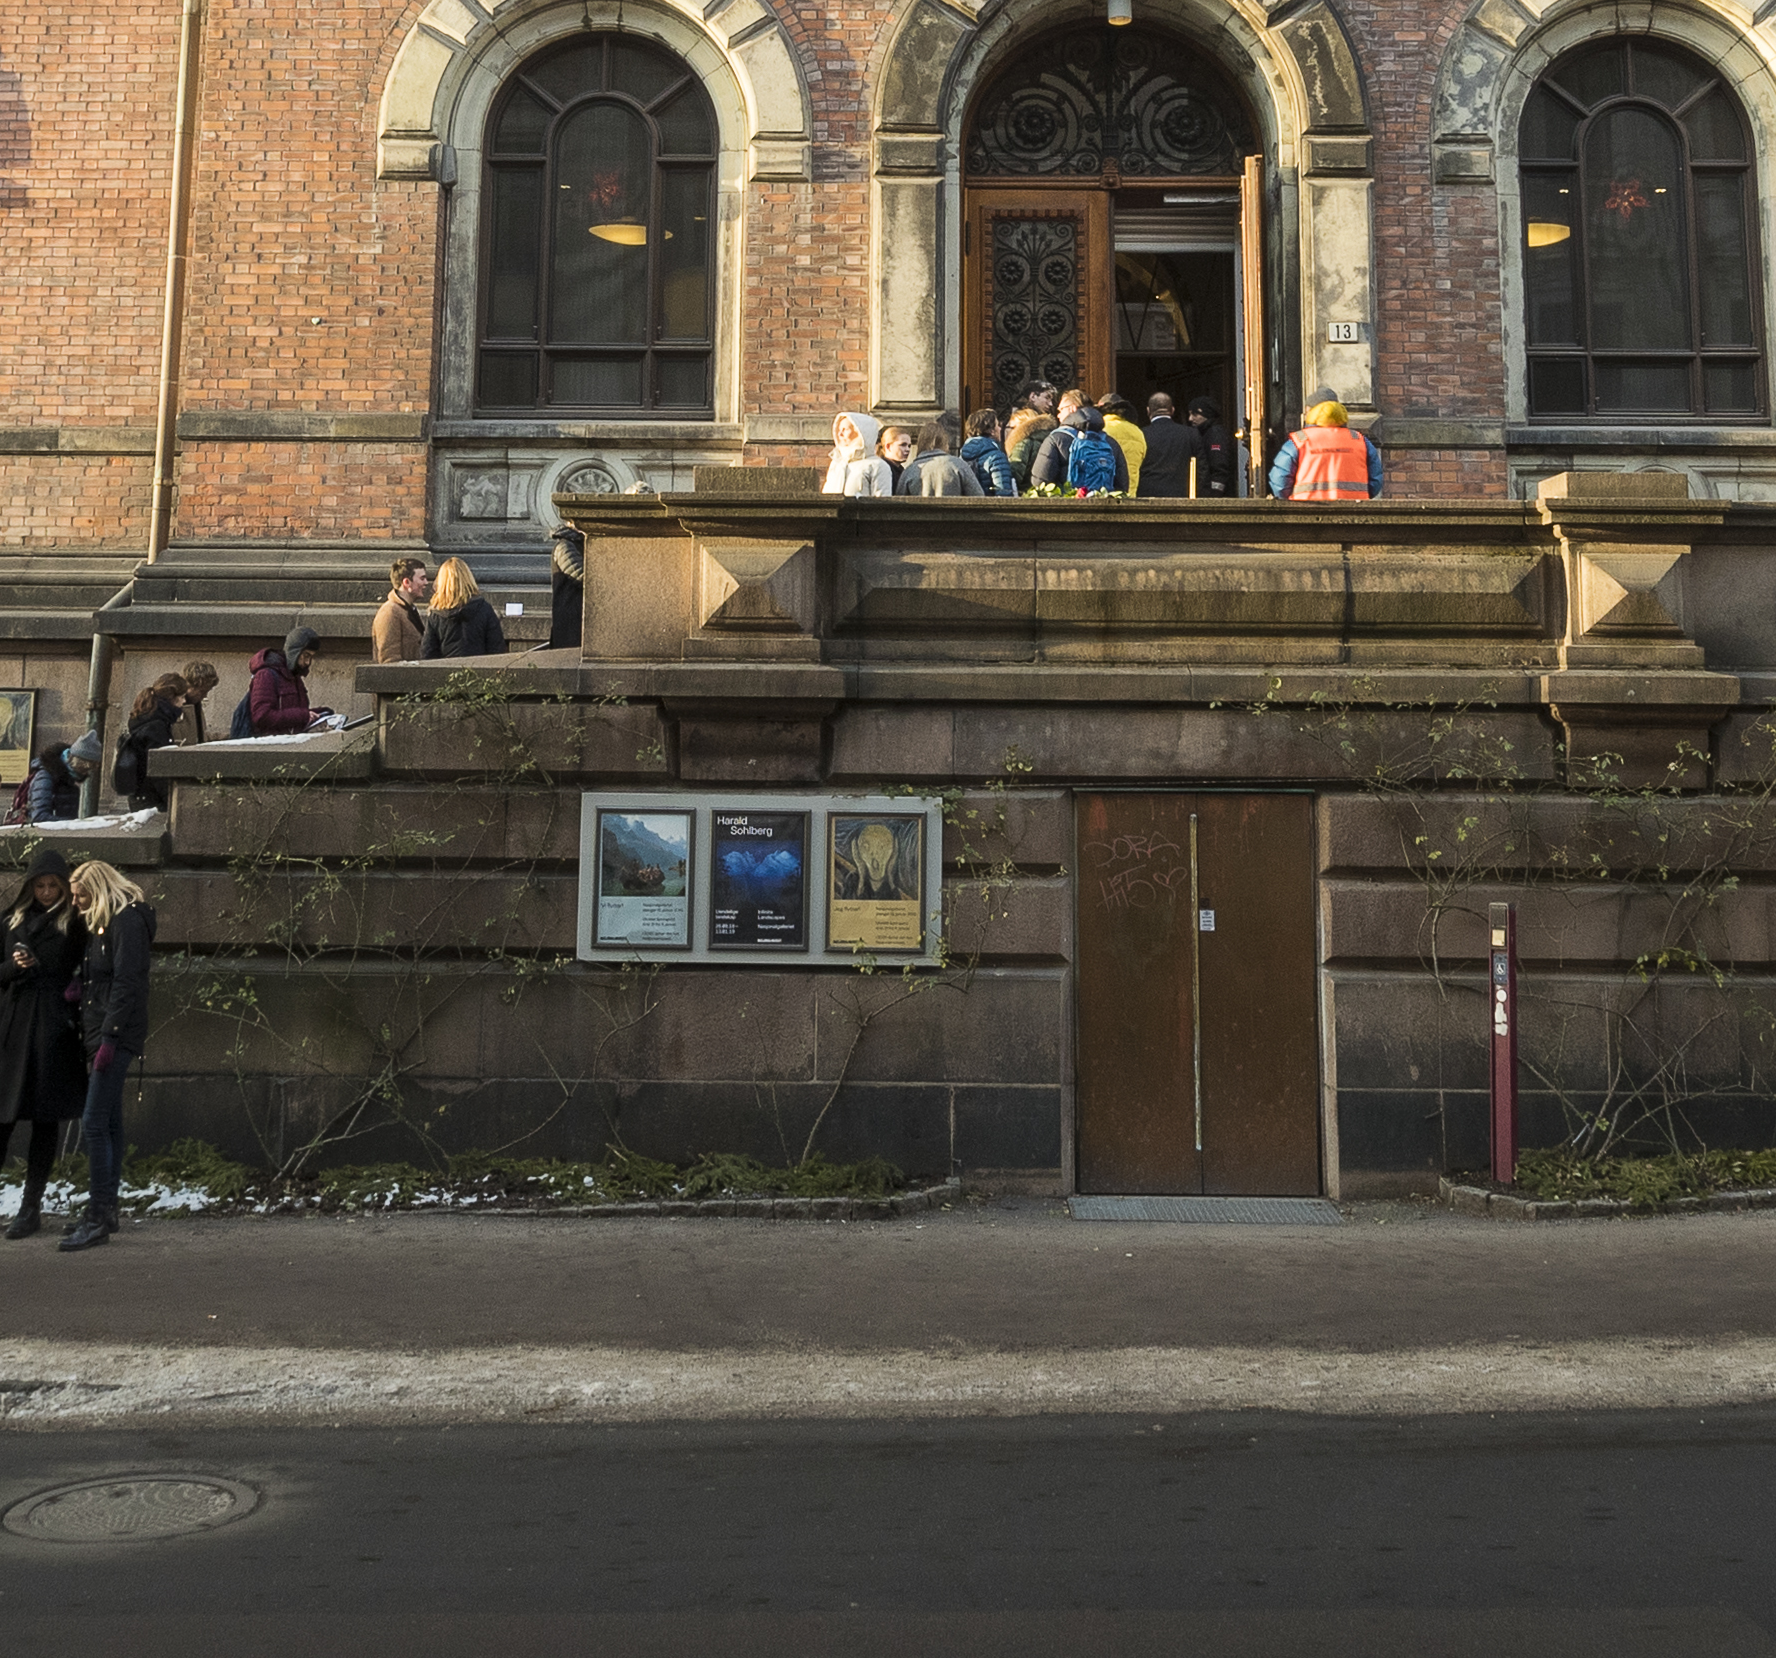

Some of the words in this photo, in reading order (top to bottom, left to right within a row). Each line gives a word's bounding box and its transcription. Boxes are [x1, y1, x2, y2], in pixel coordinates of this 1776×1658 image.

[1335, 324, 1352, 340] 13
[717, 816, 748, 825] Harald
[730, 825, 773, 838] Sohlberg
